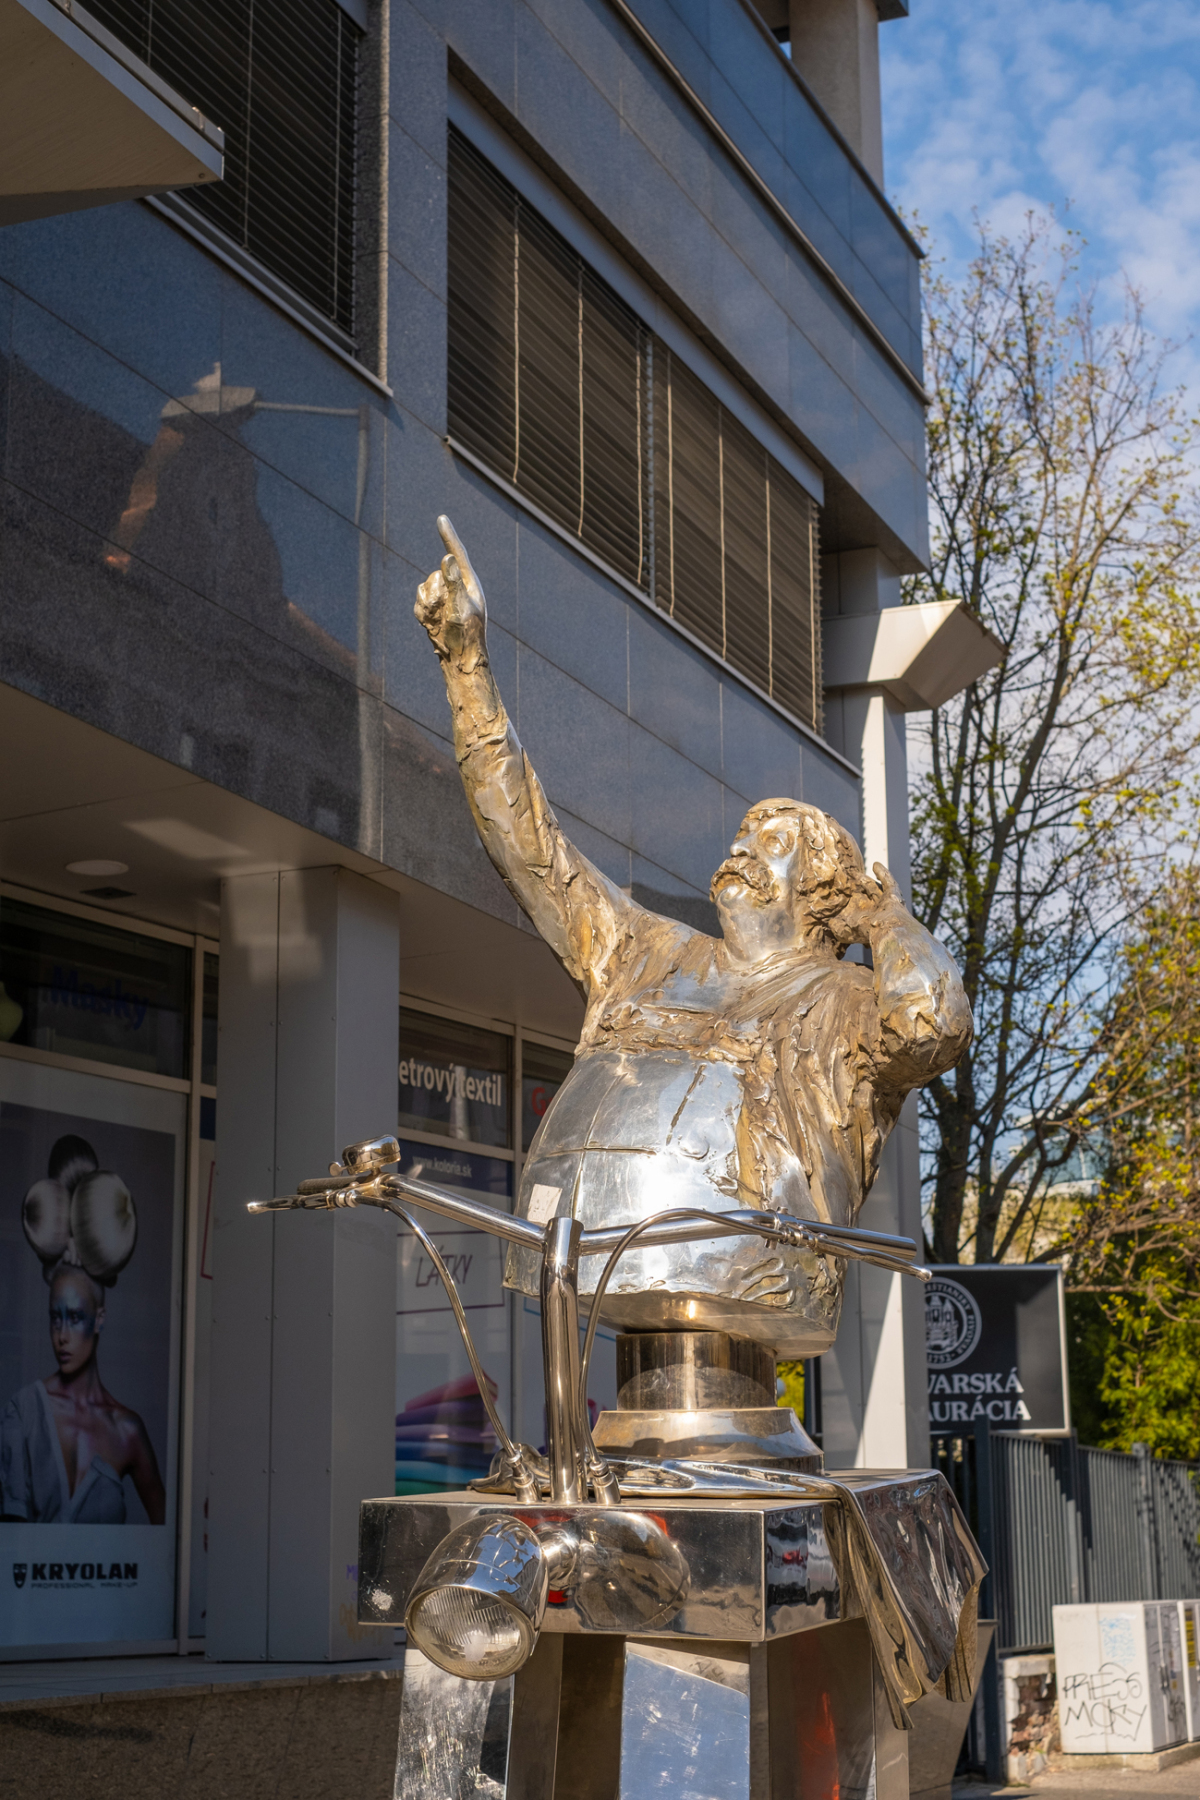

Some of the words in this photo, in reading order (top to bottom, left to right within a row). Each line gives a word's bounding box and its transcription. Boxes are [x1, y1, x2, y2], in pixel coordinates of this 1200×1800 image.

[51, 965, 149, 1030] Masky
[460, 1072, 501, 1107] textil
[32, 1563, 138, 1580] KRYOLAN
